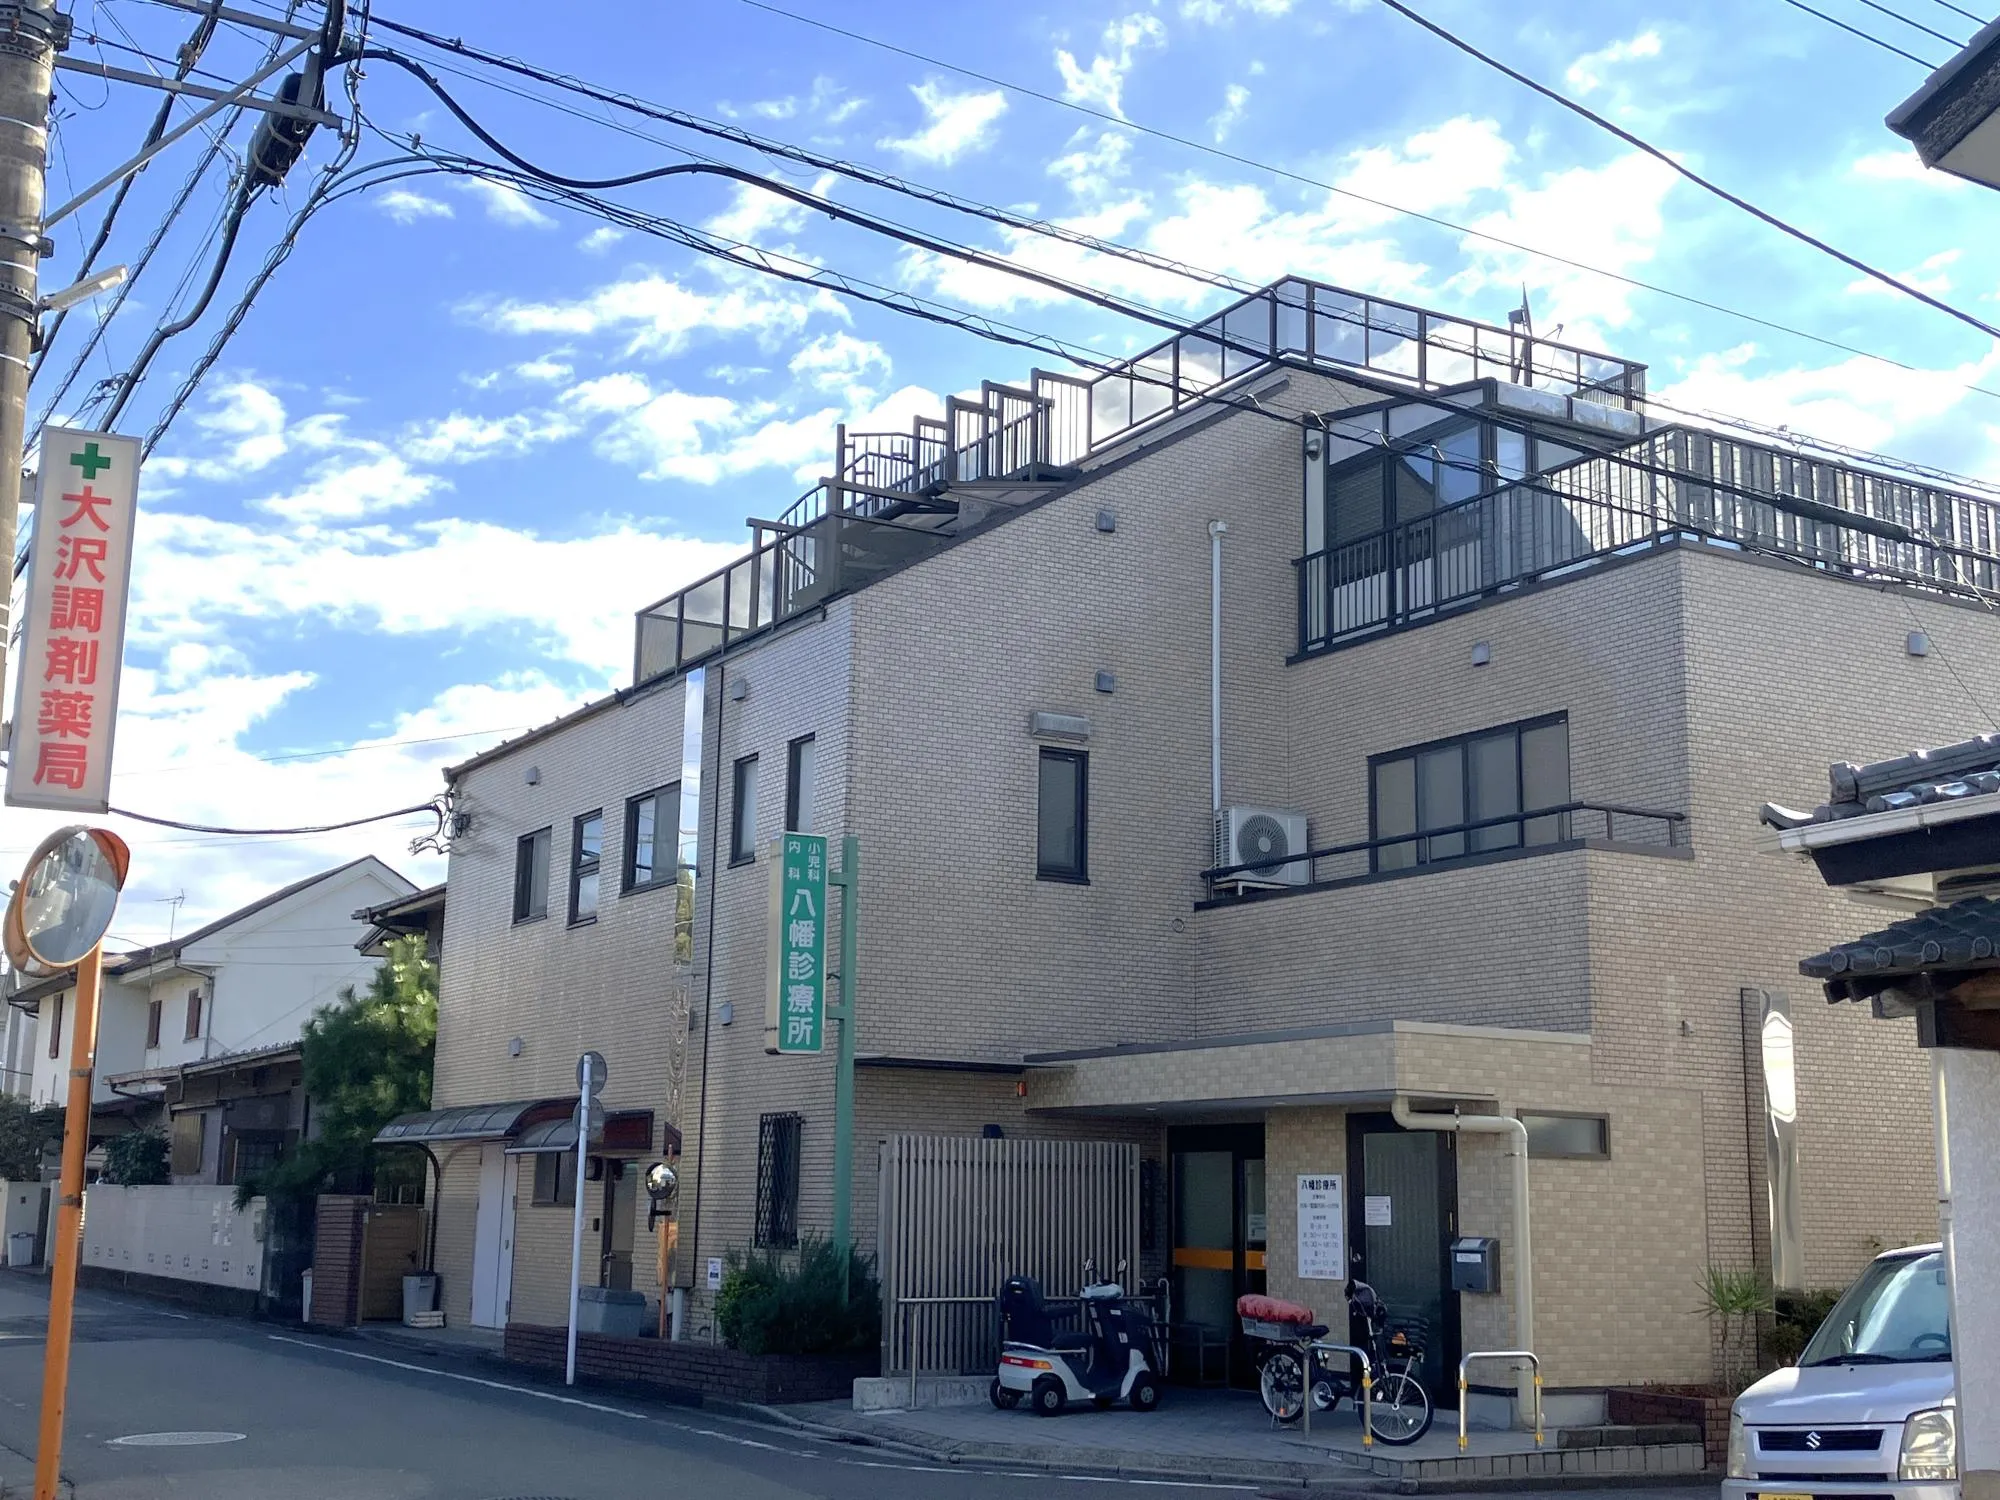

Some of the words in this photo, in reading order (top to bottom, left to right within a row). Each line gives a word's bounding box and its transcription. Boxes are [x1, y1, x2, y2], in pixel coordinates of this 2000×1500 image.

[33, 486, 112, 789] 大沢調剤薬局
[788, 841, 800, 881] 内科
[807, 842, 821, 883] 小児科
[787, 888, 816, 1046] 八幡診療所
